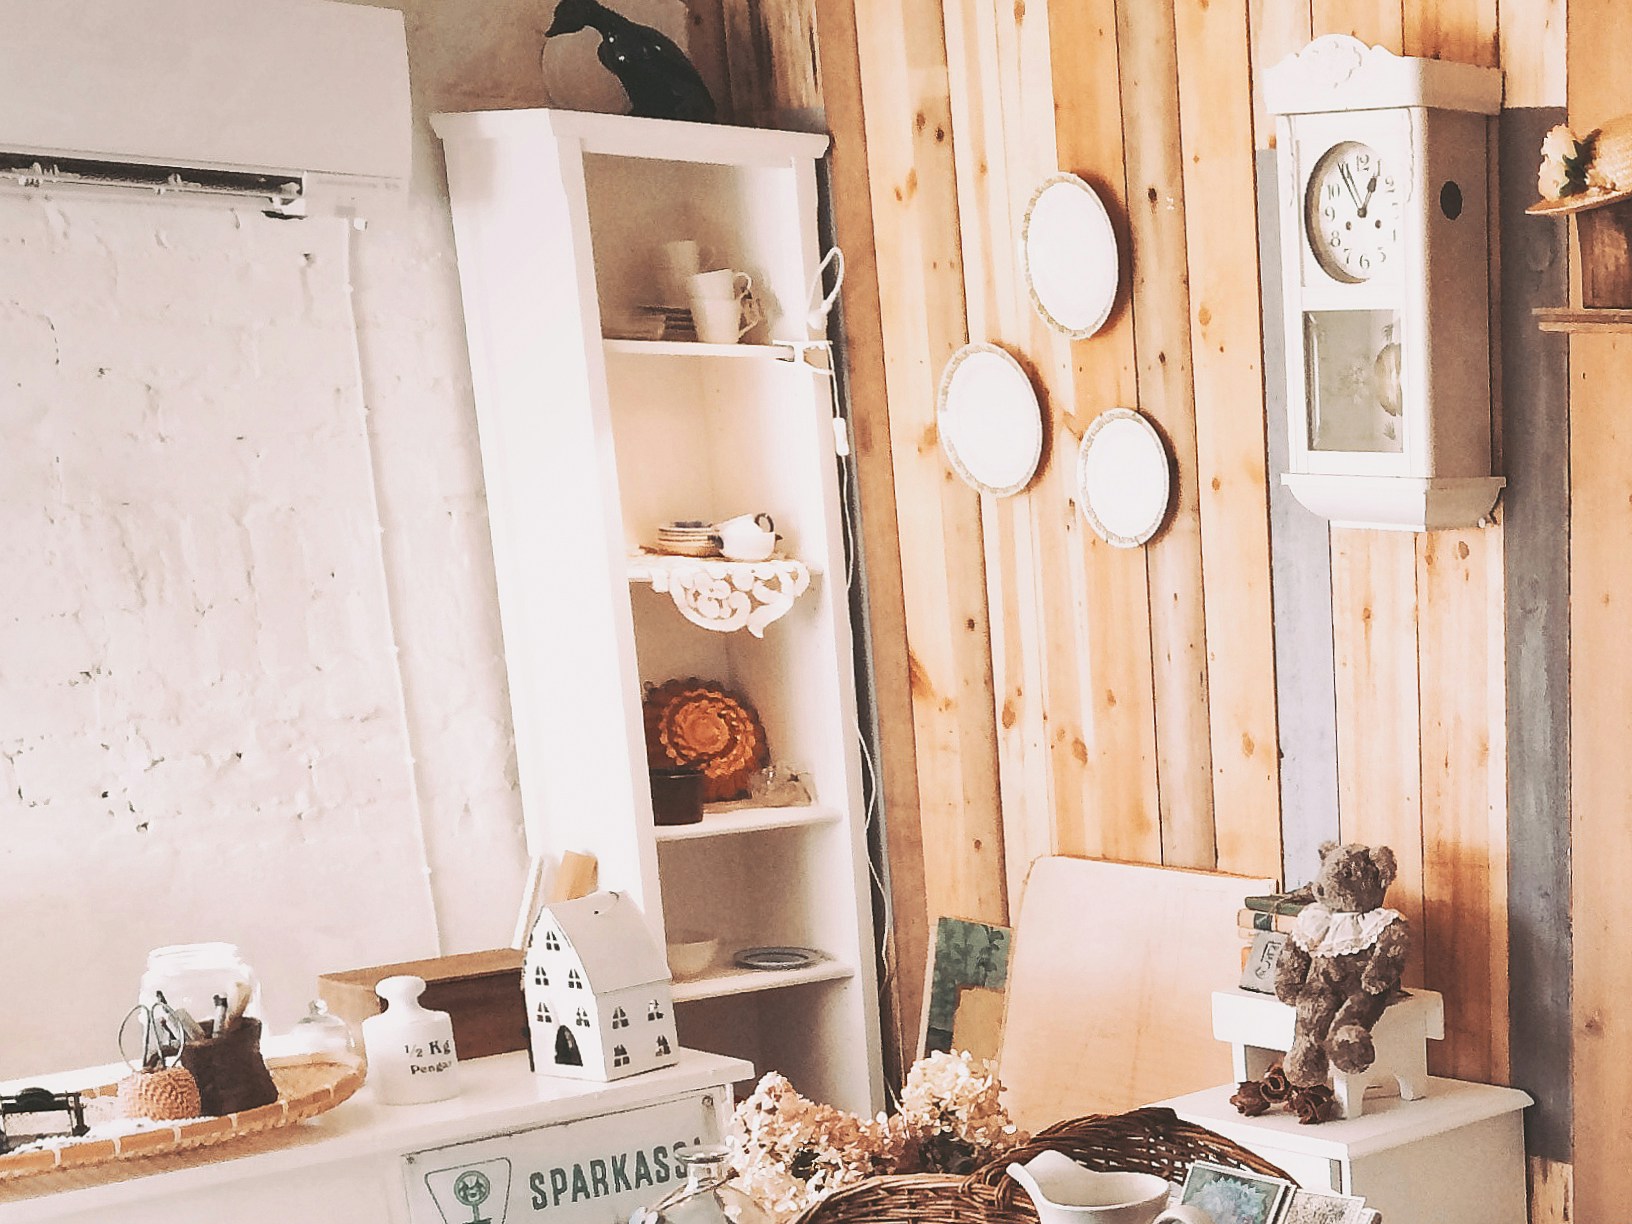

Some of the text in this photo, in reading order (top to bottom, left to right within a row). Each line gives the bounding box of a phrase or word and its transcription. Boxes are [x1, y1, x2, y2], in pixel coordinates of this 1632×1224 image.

[1356, 154, 1370, 172] 12
[1327, 183, 1340, 201] 10
[1385, 175, 1395, 193] 2
[1324, 206, 1336, 222] 9
[1330, 230, 1341, 247] 8
[1343, 248, 1352, 265] 7
[1359, 254, 1370, 270] 6
[429, 1040, 451, 1055] Kg
[528, 1136, 701, 1211] SPARKASS
